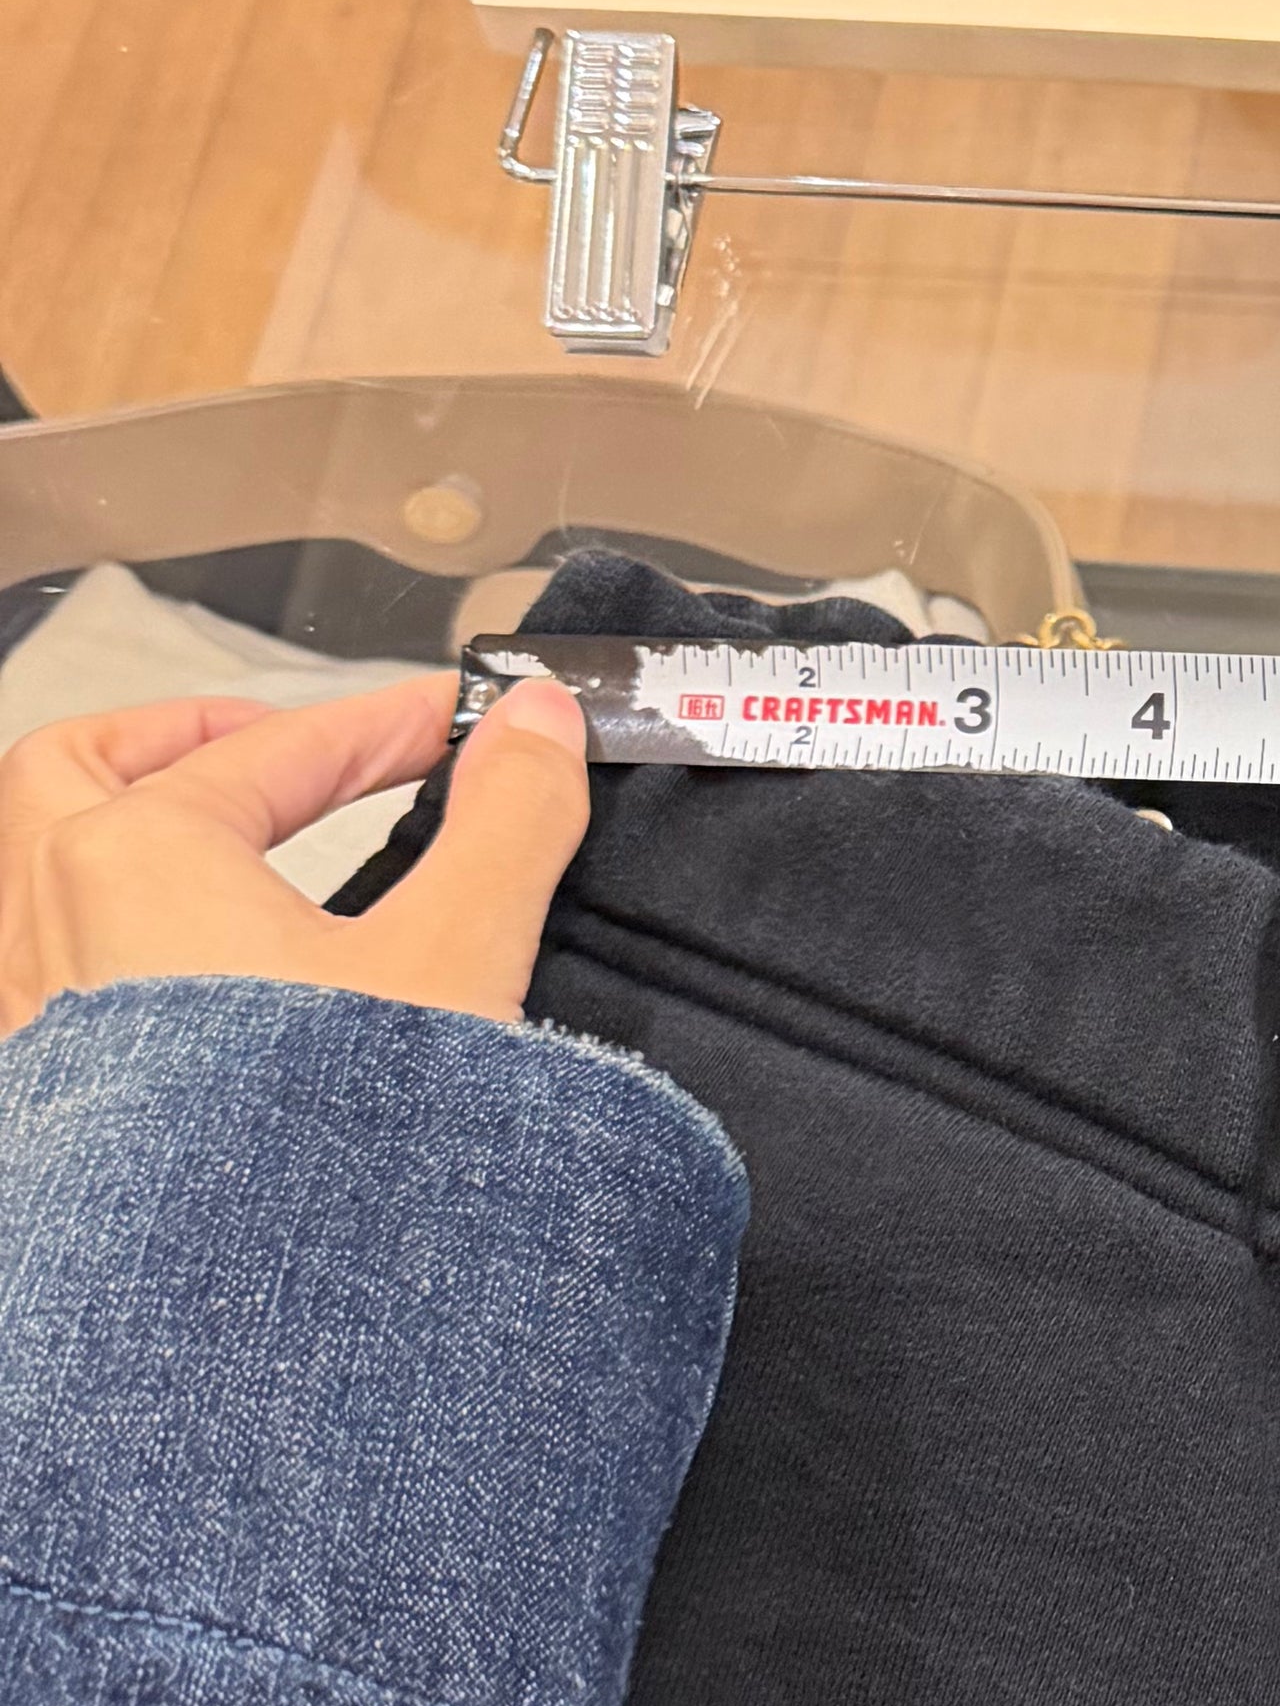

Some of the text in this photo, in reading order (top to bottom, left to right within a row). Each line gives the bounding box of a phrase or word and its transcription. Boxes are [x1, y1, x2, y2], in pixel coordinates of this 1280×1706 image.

[799, 667, 816, 688] 2
[688, 698, 718, 717] 16 ft
[953, 687, 992, 735] 3
[1131, 692, 1170, 741] 4
[794, 725, 813, 745] 2
